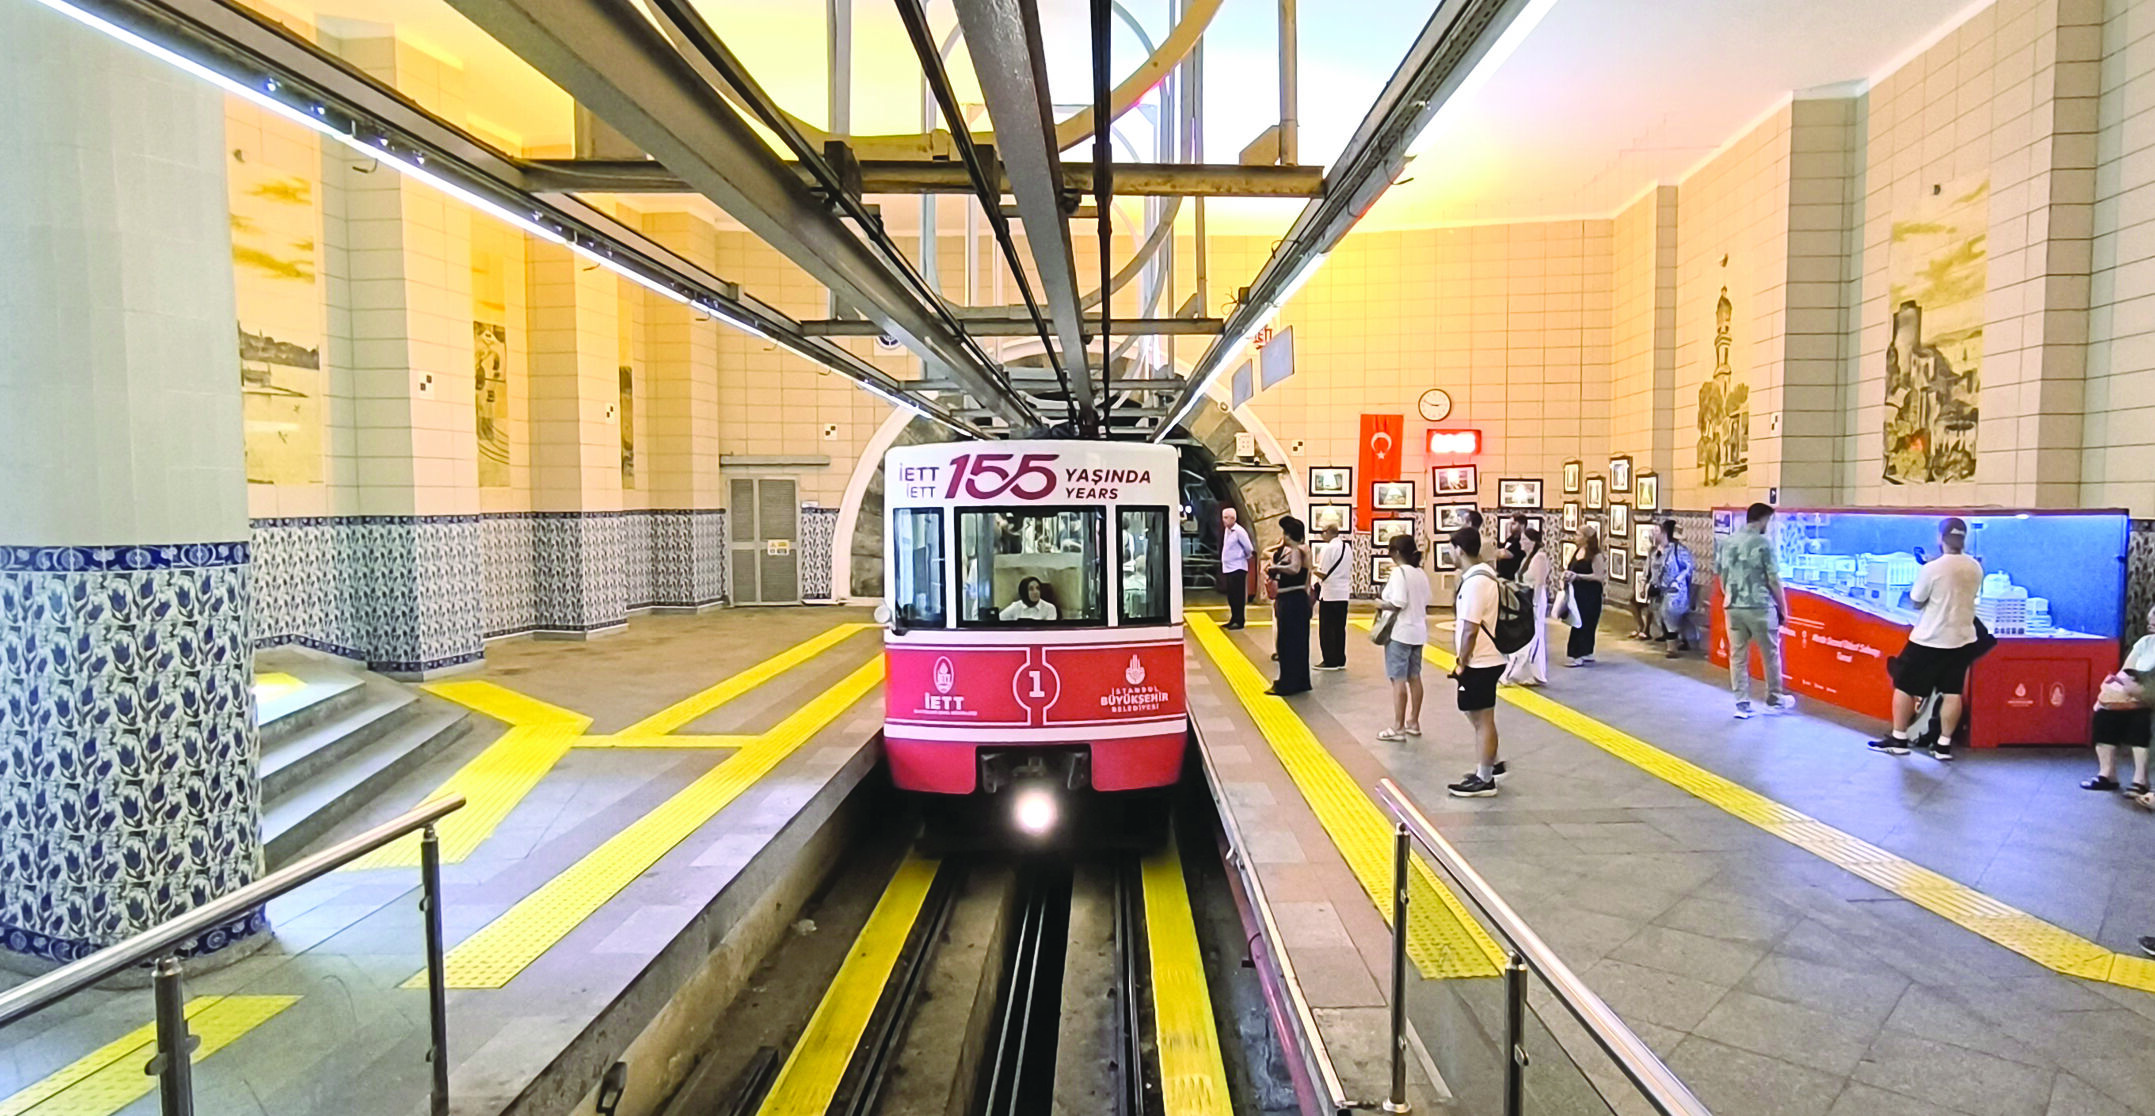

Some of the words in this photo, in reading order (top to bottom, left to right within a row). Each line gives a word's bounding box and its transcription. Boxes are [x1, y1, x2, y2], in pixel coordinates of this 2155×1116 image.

[899, 463, 940, 482] İETT
[944, 453, 1060, 500] 155
[1065, 468, 1152, 486] YAŞINDA
[906, 483, 936, 499] İETT
[1065, 486, 1119, 500] YEARS
[1028, 670, 1046, 698] 1
[924, 692, 965, 711] İETT
[1100, 692, 1169, 706] BÜYÜKŞEHİR
[1111, 703, 1160, 713] BELEDİYESİ
